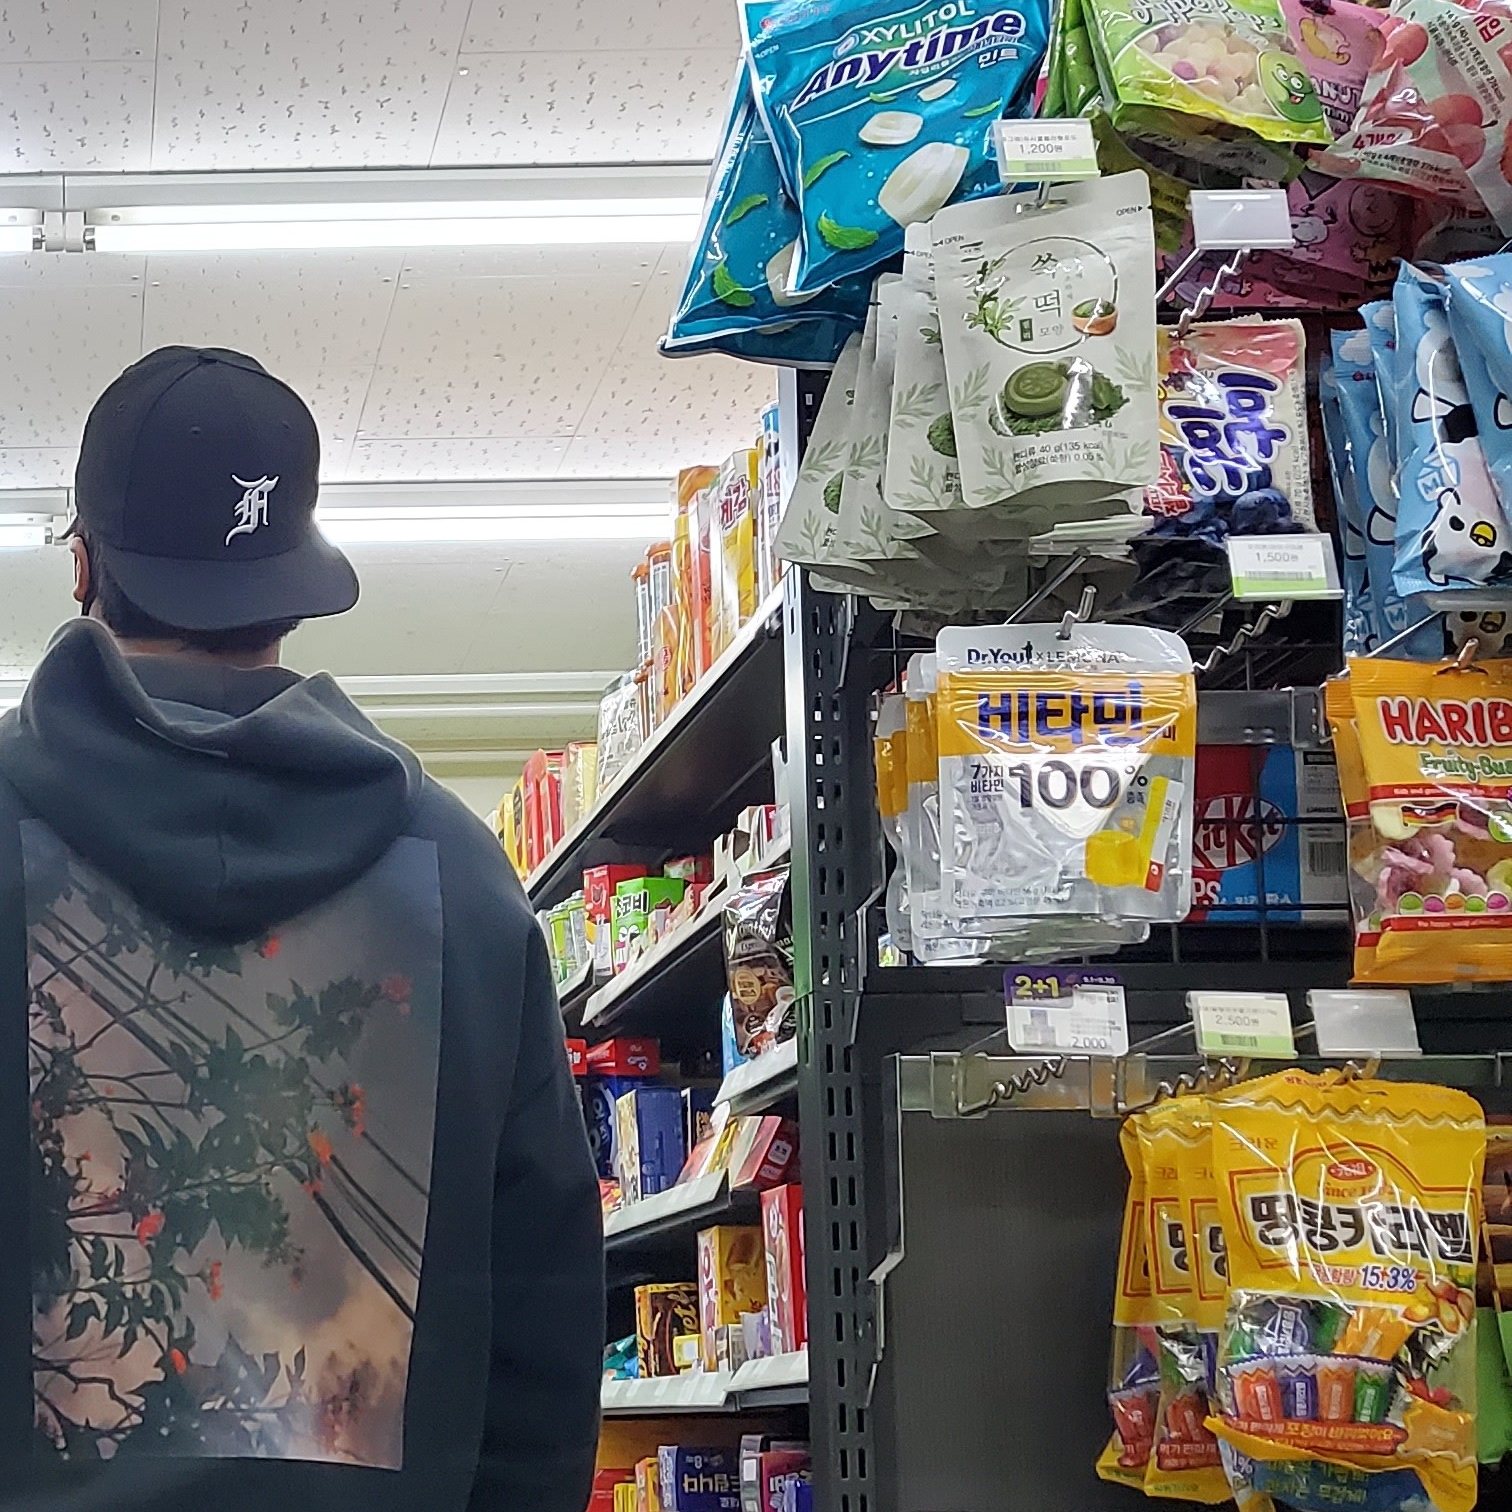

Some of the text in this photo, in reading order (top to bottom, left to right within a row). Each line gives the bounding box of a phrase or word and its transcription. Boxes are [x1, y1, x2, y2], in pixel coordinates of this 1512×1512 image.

[859, 0, 976, 45] XYLITOL
[792, 10, 1026, 106] Anytime
[977, 50, 1020, 70] 민트
[1018, 142, 1064, 155] 1,200원
[977, 680, 1146, 746] 비타민
[969, 763, 1004, 779] 7가지
[1007, 759, 1121, 809] 100
[969, 779, 1004, 793] 비타민
[1015, 975, 1059, 999] 2+1
[1359, 1264, 1418, 1292] 15.3%
